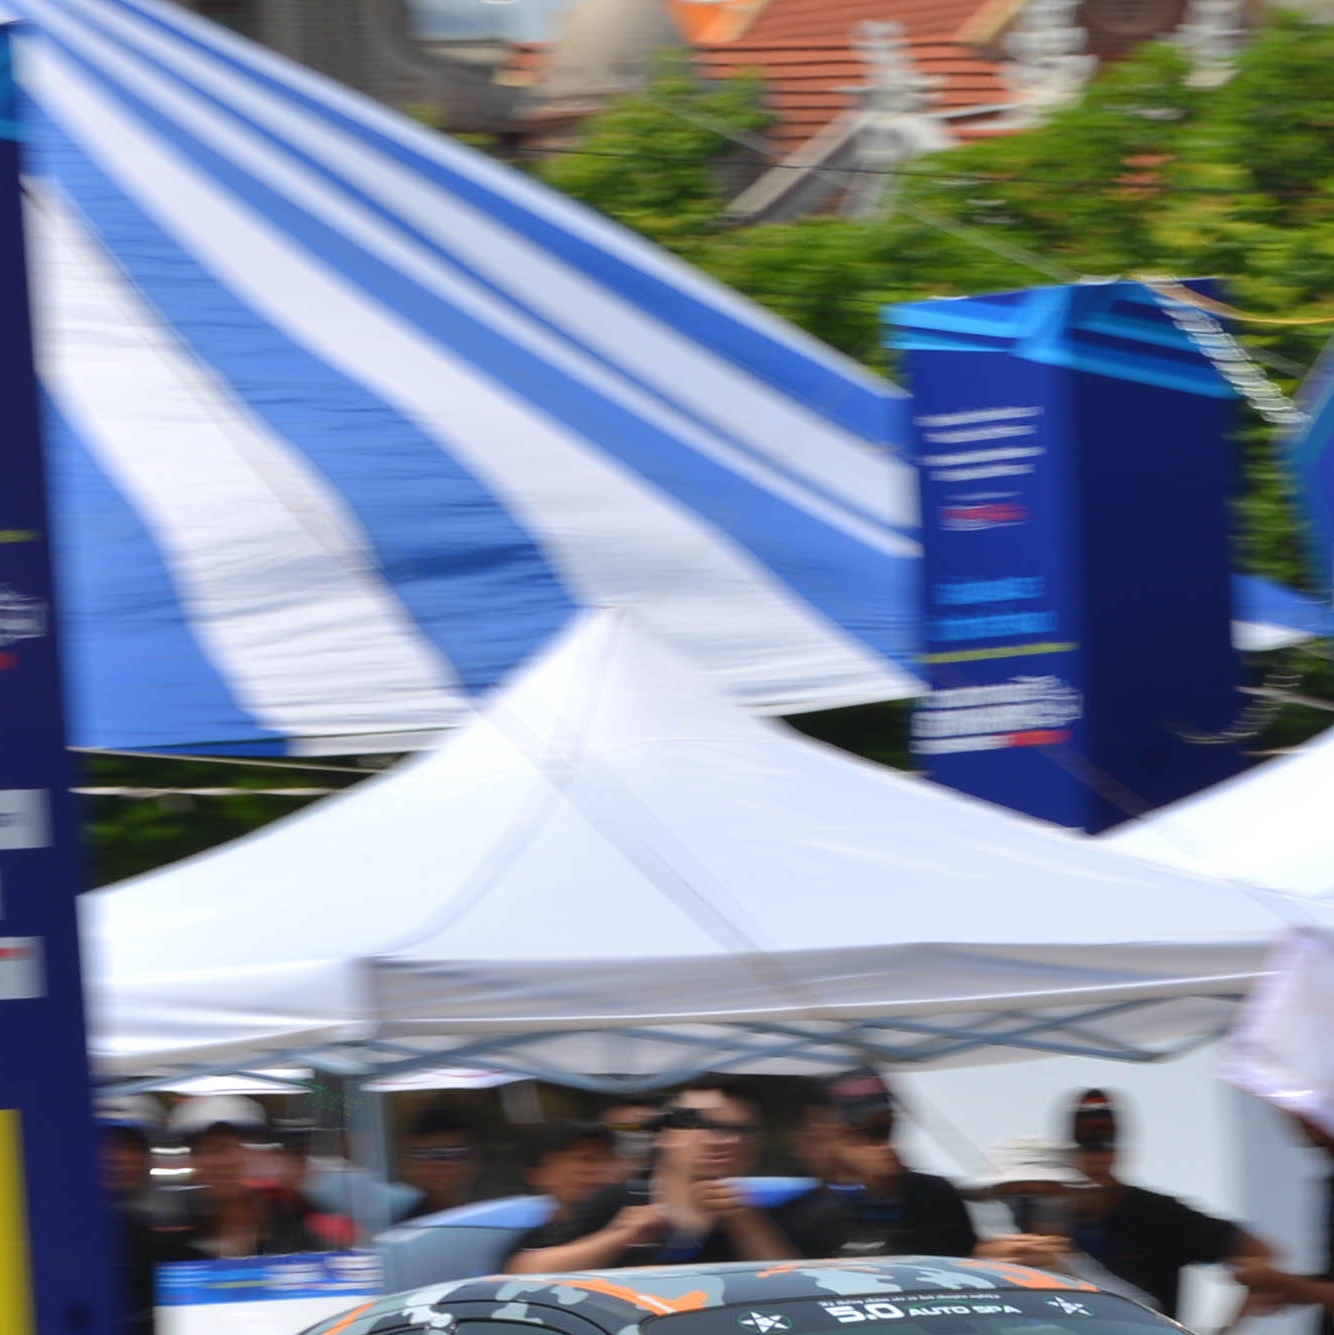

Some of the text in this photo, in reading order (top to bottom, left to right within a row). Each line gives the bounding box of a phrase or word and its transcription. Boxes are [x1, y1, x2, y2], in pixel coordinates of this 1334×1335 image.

[824, 1303, 1023, 1324] 5.0 AUTO SPA
